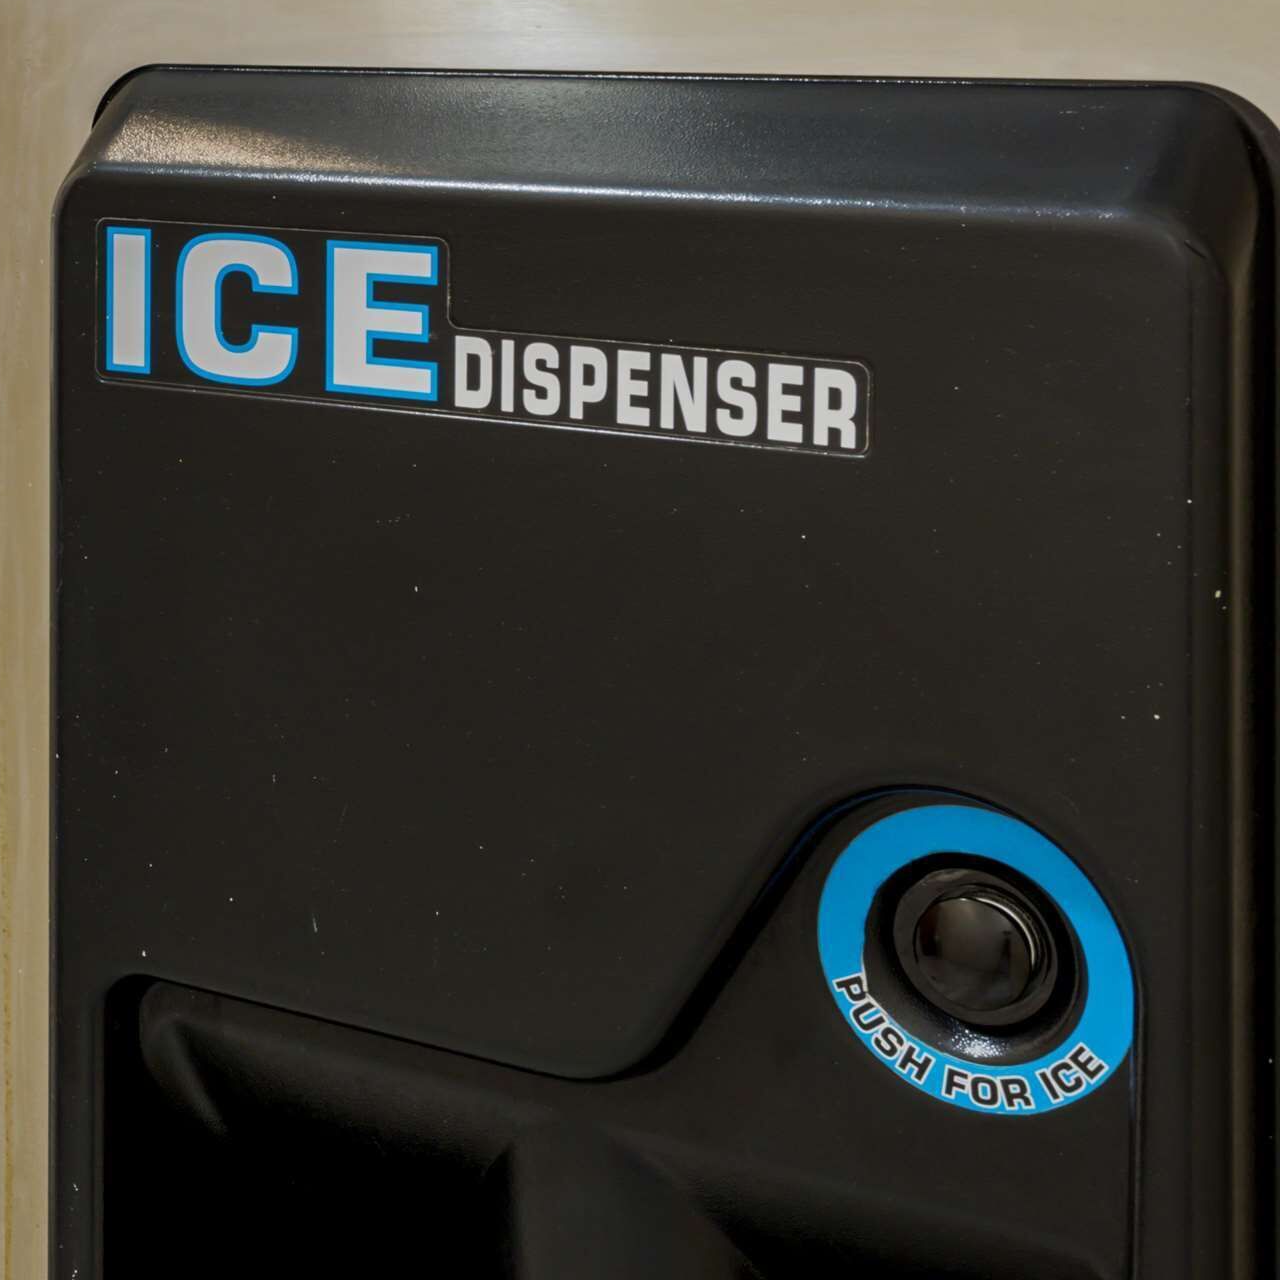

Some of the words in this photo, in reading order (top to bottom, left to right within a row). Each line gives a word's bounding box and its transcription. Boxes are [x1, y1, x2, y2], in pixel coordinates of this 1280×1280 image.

[105, 226, 439, 402] ICE
[454, 335, 858, 449] DISPENSER
[832, 972, 936, 1085] PUSH
[941, 1064, 1035, 1111] FOR
[1036, 1042, 1109, 1104] ICE
